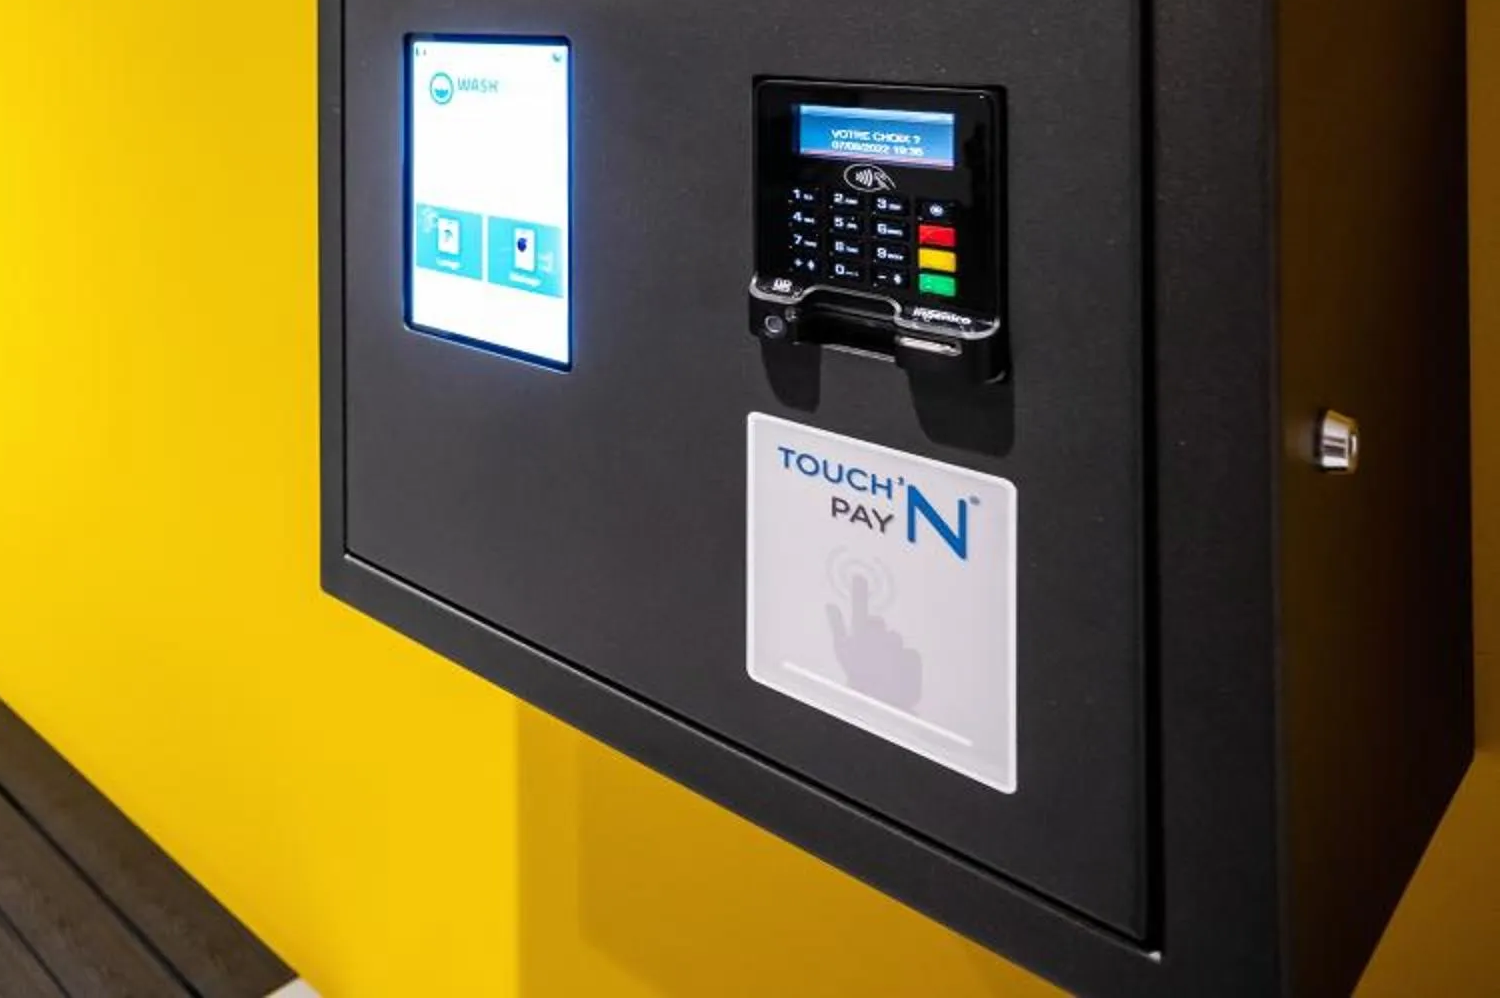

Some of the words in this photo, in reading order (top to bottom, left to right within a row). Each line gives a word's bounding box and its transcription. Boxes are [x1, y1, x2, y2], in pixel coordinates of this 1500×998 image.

[457, 77, 499, 94] WASH
[831, 129, 871, 141] VOTRE
[872, 131, 912, 144] CHOIX
[792, 188, 801, 200] 1
[833, 192, 844, 203] 2
[792, 211, 802, 221] 4
[793, 233, 802, 245] 7
[835, 263, 845, 275] 0
[831, 496, 895, 534] PAY
